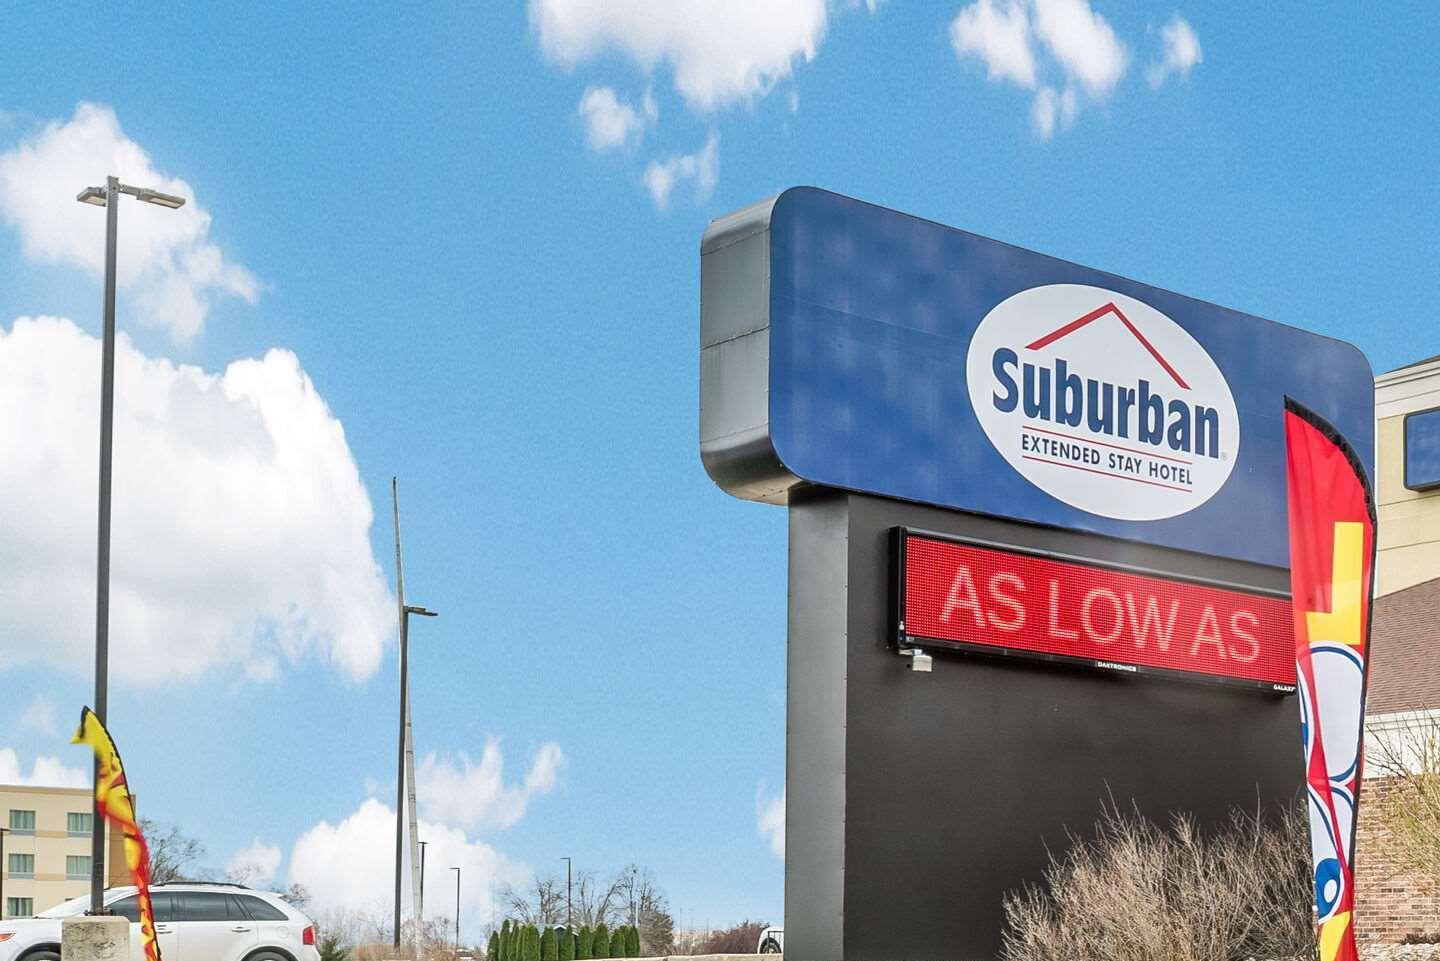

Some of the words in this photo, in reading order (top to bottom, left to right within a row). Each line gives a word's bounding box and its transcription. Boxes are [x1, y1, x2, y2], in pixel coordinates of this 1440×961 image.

[992, 347, 1219, 459] Suburban
[1022, 434, 1100, 465] EXTENDED
[1108, 453, 1142, 474] STAY
[1149, 461, 1192, 485] HOTEL
[939, 565, 1027, 632] AS
[1049, 579, 1180, 652] LOW
[1190, 605, 1260, 663] AS
[1097, 661, 1137, 672] DAKTRONICS
